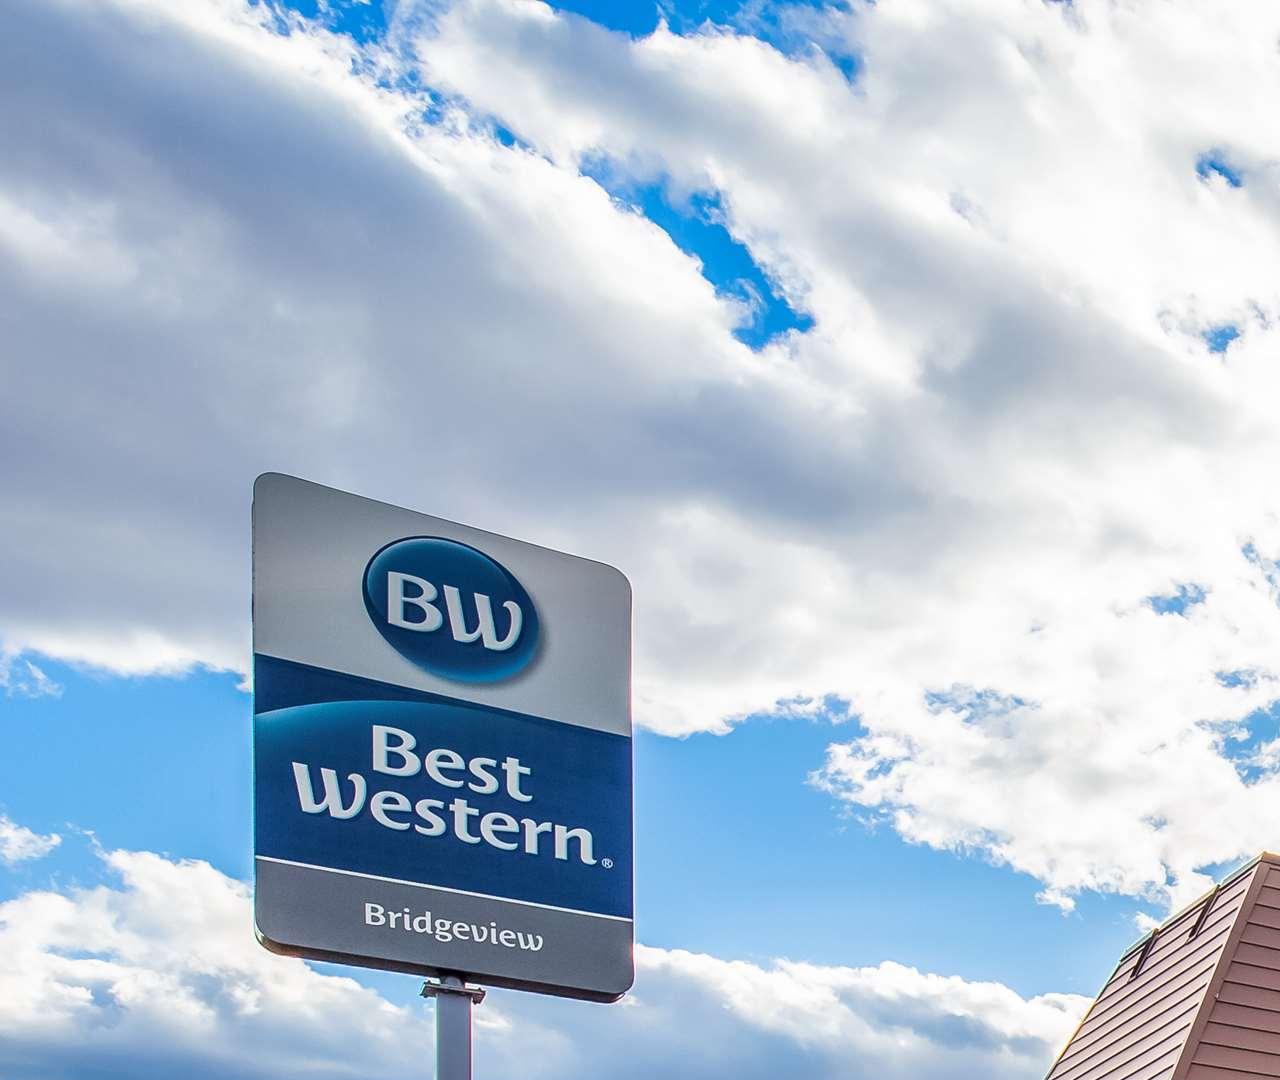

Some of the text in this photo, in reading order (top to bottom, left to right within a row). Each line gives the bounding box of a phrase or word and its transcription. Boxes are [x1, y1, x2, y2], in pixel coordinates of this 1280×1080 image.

[387, 570, 524, 652] BW
[371, 723, 534, 803] Best
[291, 761, 598, 866] Western
[363, 901, 545, 953] Bridgeview
